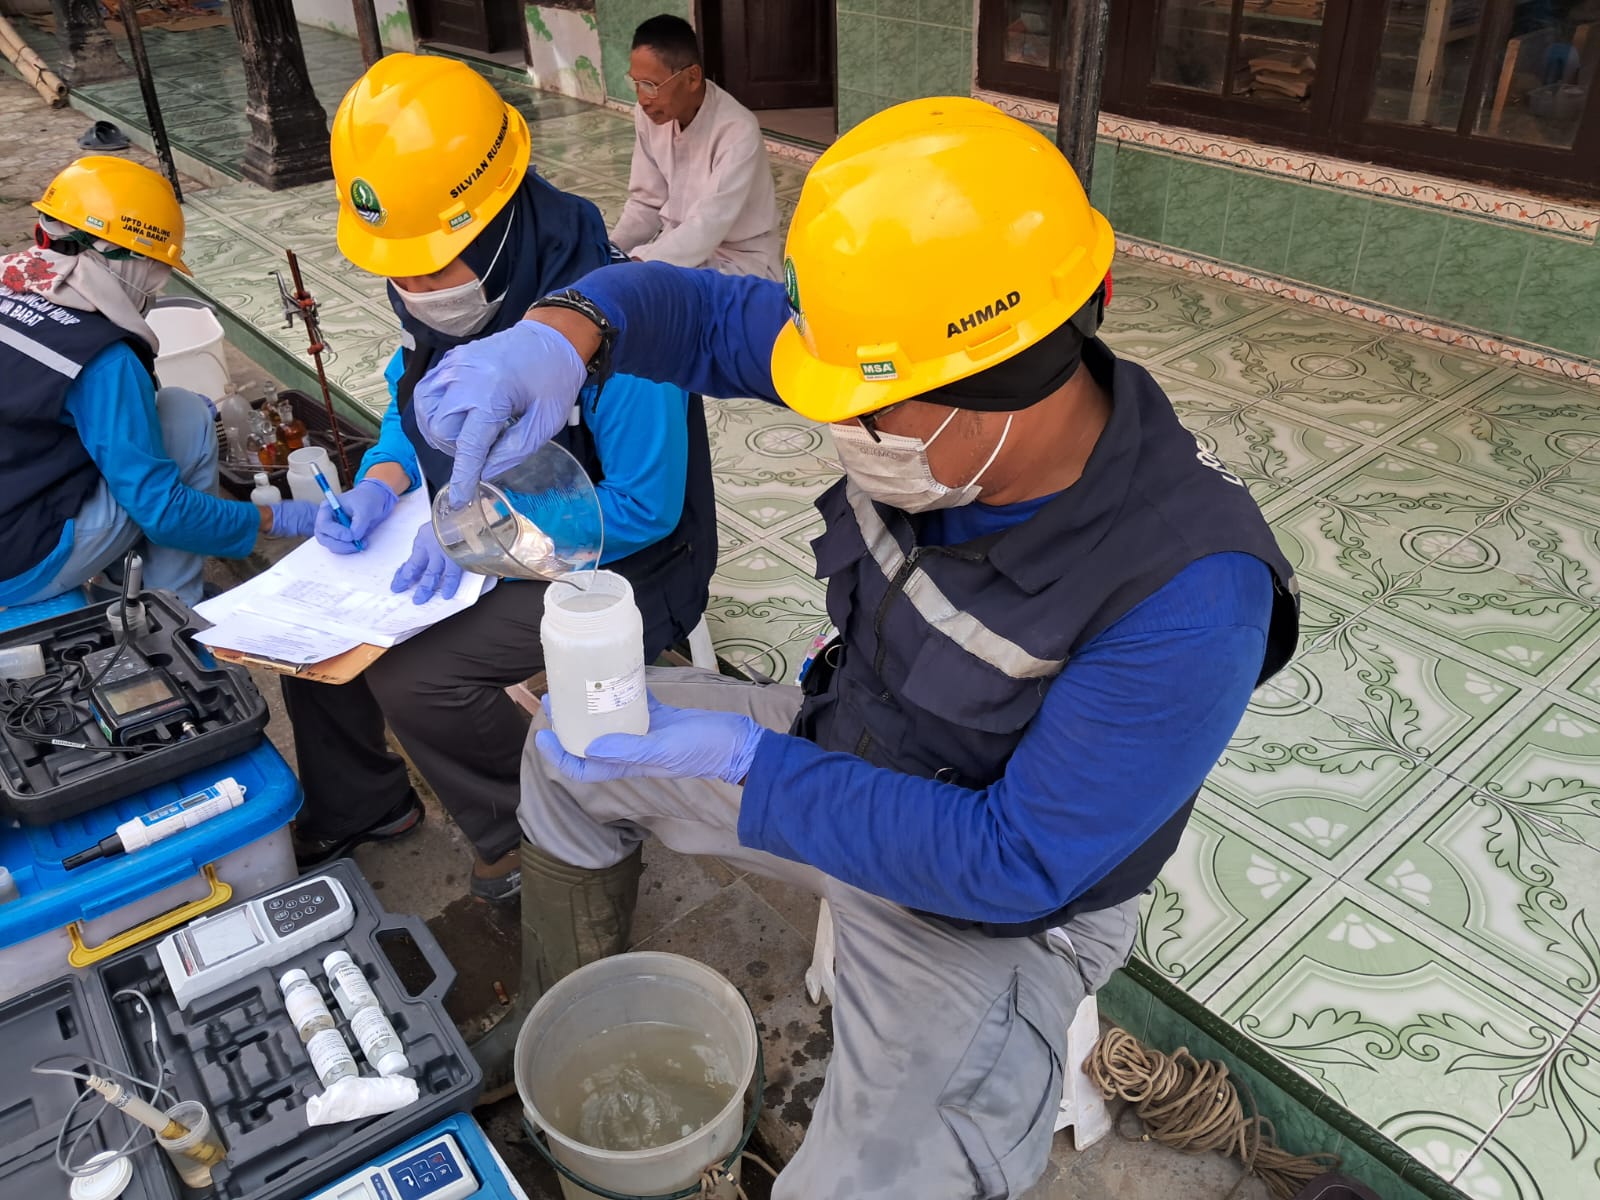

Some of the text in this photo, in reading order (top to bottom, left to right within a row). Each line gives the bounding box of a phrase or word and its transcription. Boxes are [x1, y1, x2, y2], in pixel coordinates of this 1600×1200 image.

[449, 159, 489, 199] SILVIAN
[121, 215, 171, 238] UPTD LABLING
[123, 224, 167, 243] JAWA BARAT
[9, 304, 45, 327] BARAT
[946, 290, 1021, 338] AHMAD
[863, 363, 892, 374] MSA
